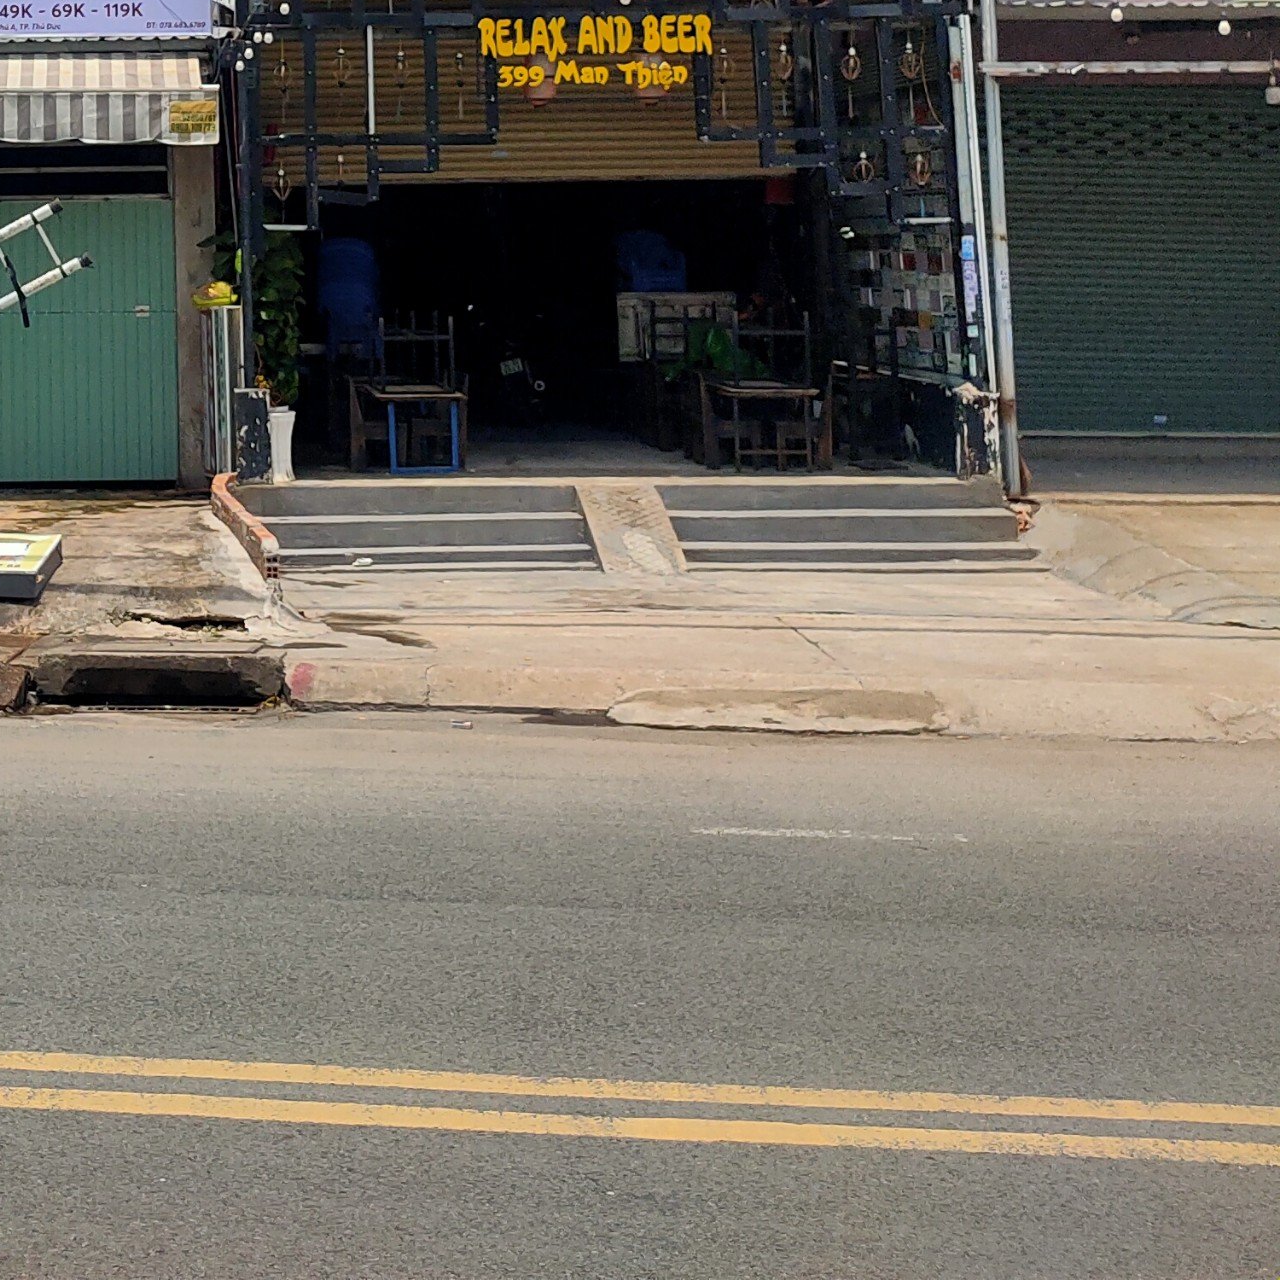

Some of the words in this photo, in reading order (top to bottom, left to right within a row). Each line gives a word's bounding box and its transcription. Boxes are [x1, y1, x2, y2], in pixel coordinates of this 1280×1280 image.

[0, 4, 33, 19] 49K
[51, 3, 85, 19] 69K
[103, 2, 144, 18] 119K
[477, 16, 568, 62] RELAX
[577, 15, 633, 55] AND
[642, 14, 713, 55] BEER
[497, 65, 545, 88] 399
[554, 59, 609, 86] Man
[617, 60, 689, 91] Thiện
